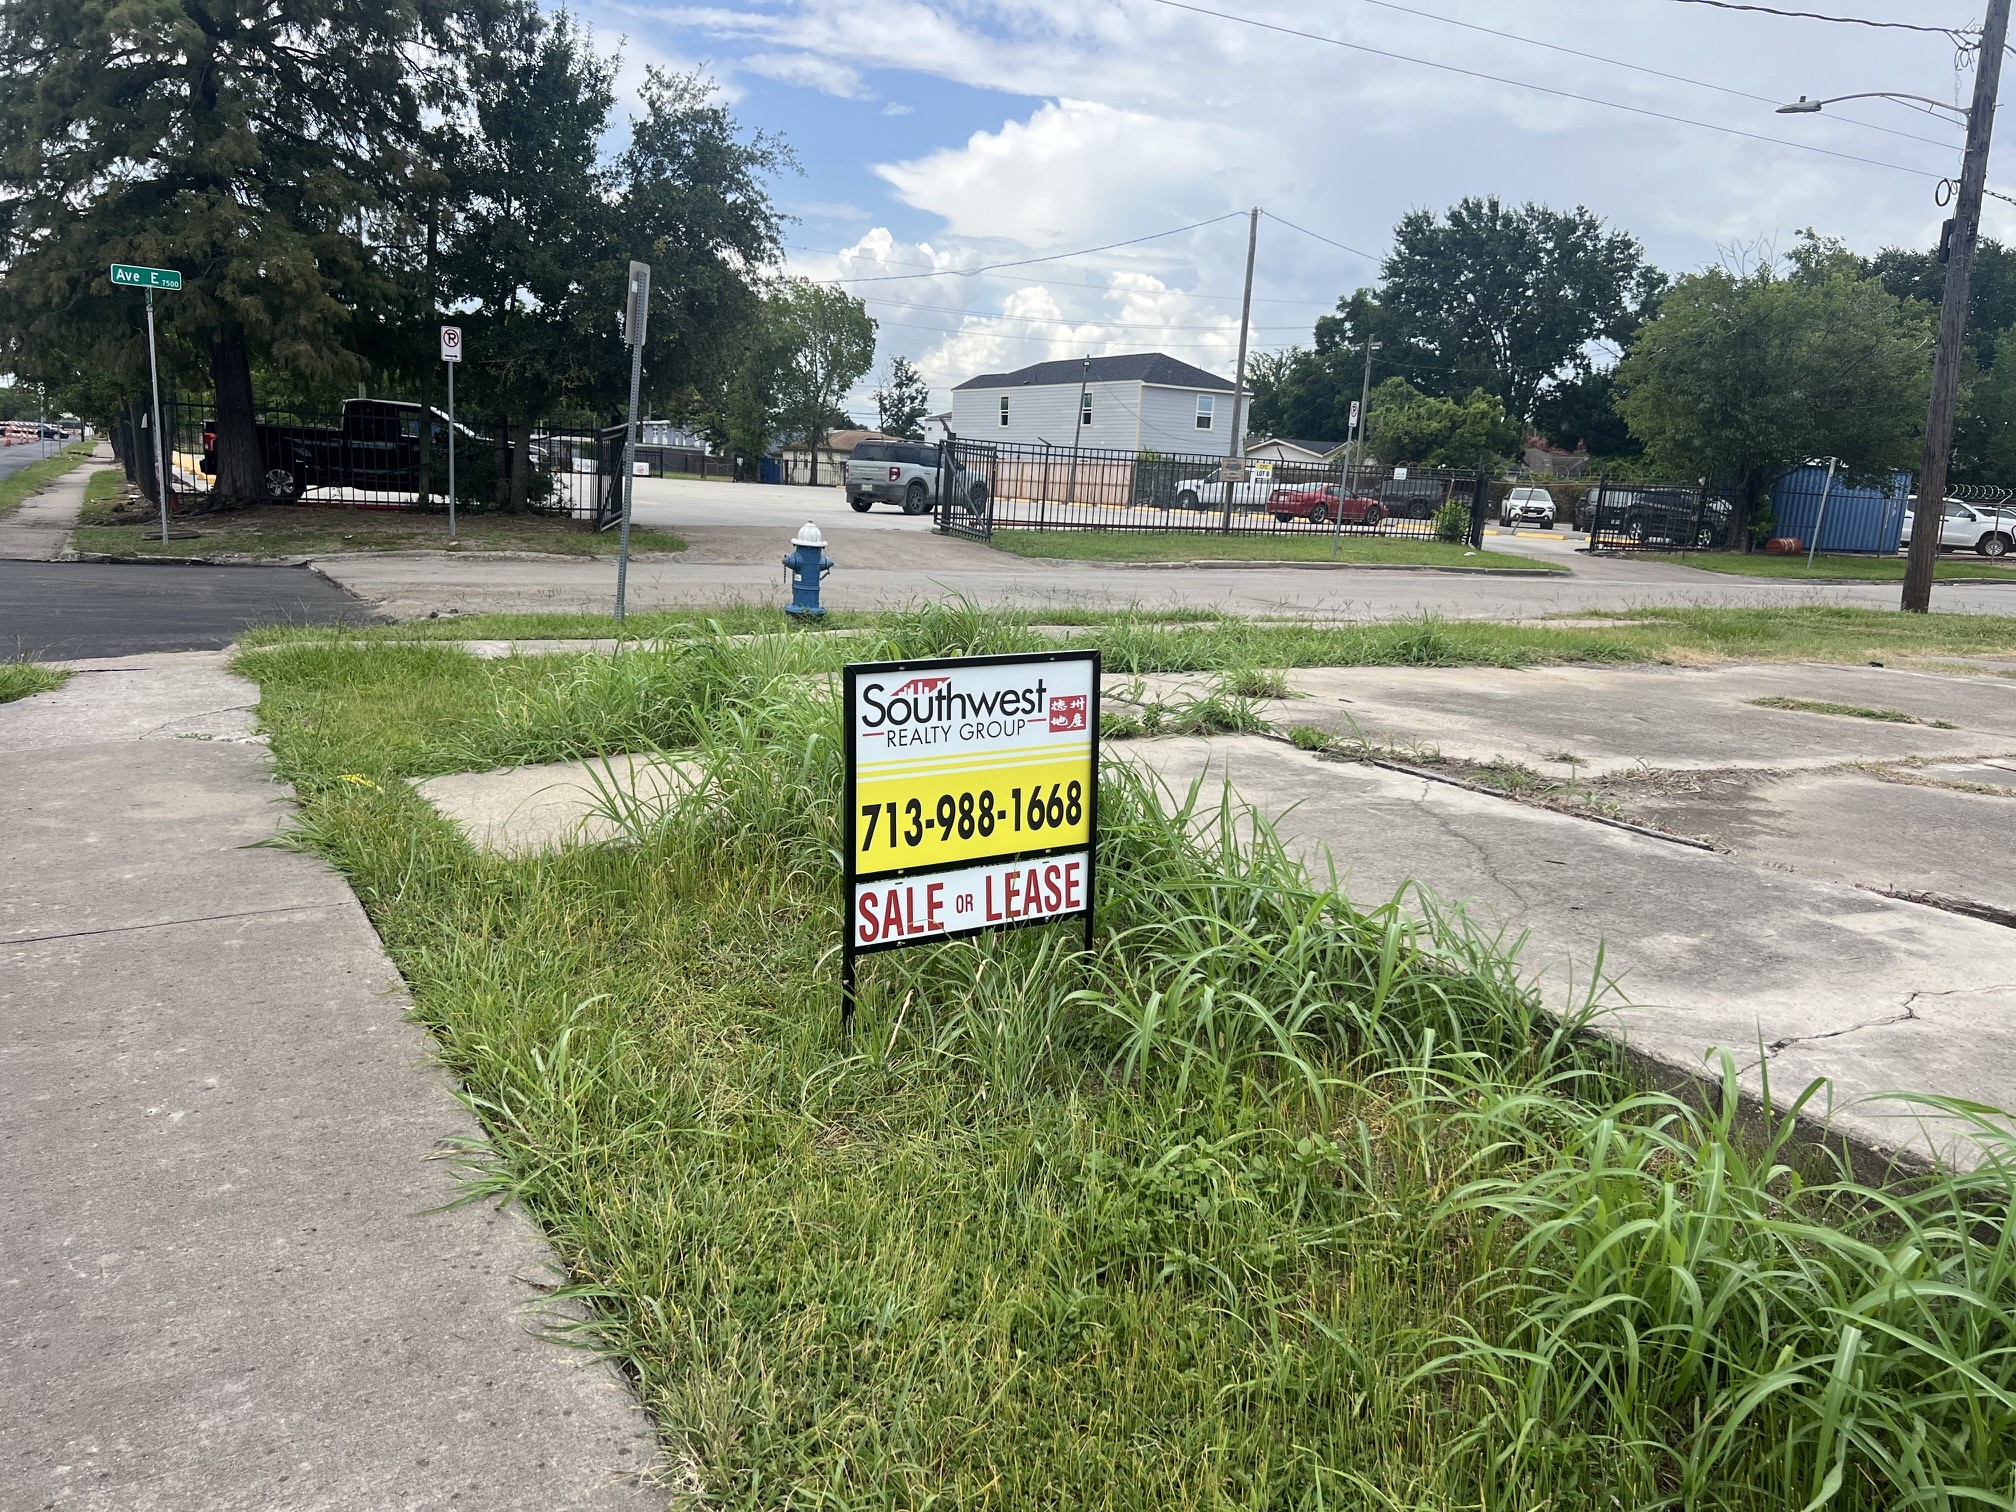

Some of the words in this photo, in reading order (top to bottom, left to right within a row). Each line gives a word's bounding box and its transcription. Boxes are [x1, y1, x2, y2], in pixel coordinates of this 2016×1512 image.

[116, 268, 140, 281] Ave
[150, 272, 159, 284] E
[161, 280, 179, 288] 7500
[861, 679, 1047, 728] Southwest
[887, 724, 952, 748] REALTY
[959, 718, 1026, 741] GROUP
[861, 780, 1082, 852] 713-988-1668
[858, 882, 945, 943] SALE
[956, 893, 974, 914] OR
[985, 862, 1081, 922] LEASE
